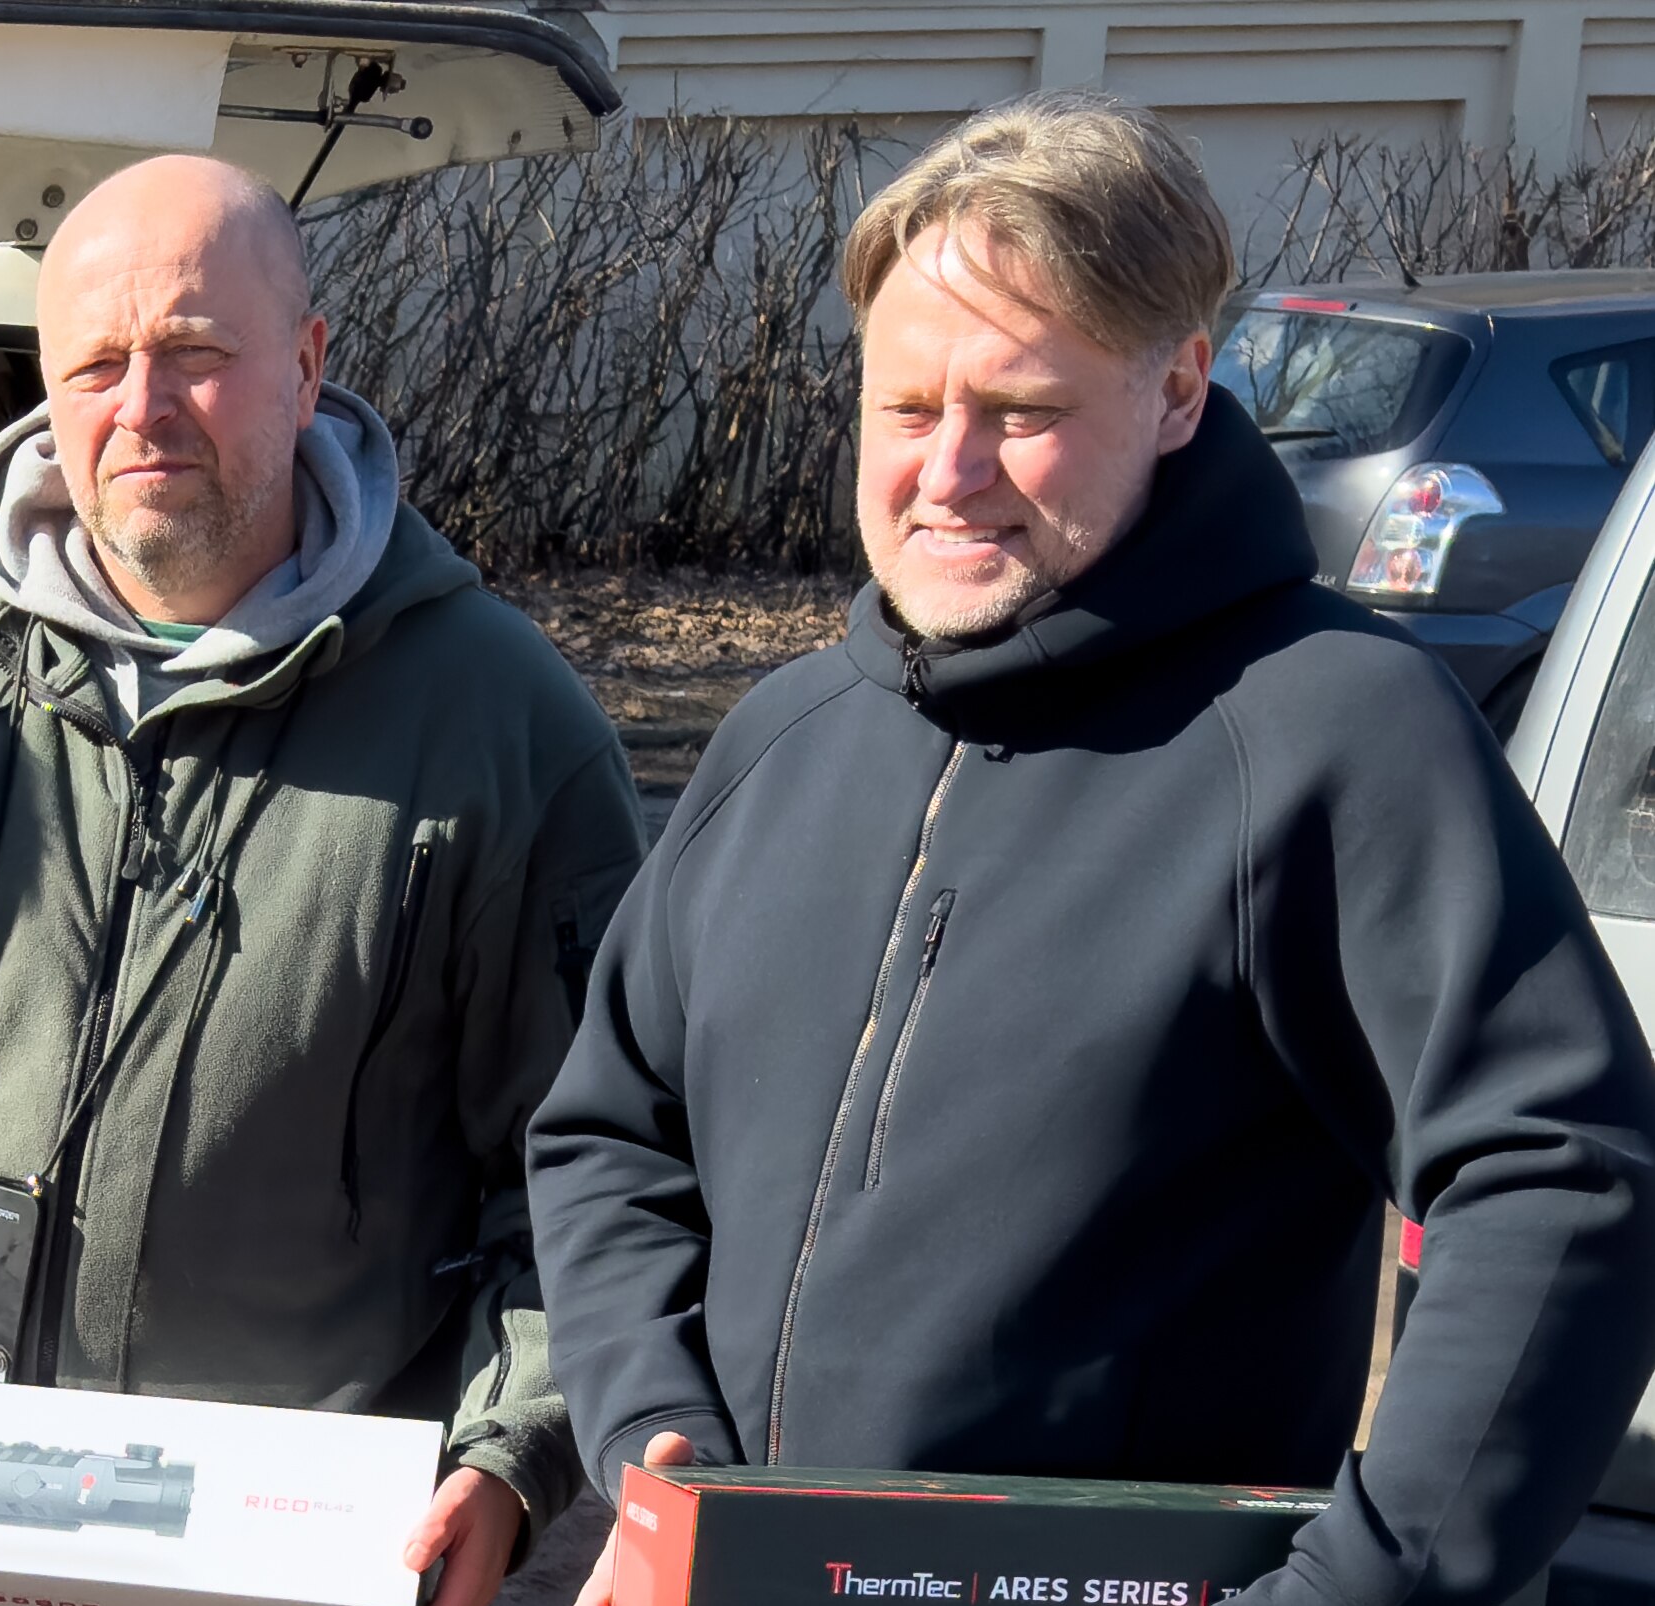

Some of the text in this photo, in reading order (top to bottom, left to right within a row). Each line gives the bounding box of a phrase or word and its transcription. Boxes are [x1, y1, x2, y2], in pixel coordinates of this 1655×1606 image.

[245, 1495, 355, 1513] RICO RL42
[825, 1562, 962, 1599] ThermTec
[989, 1576, 1068, 1602] ARES
[1082, 1579, 1189, 1606] SERIES
